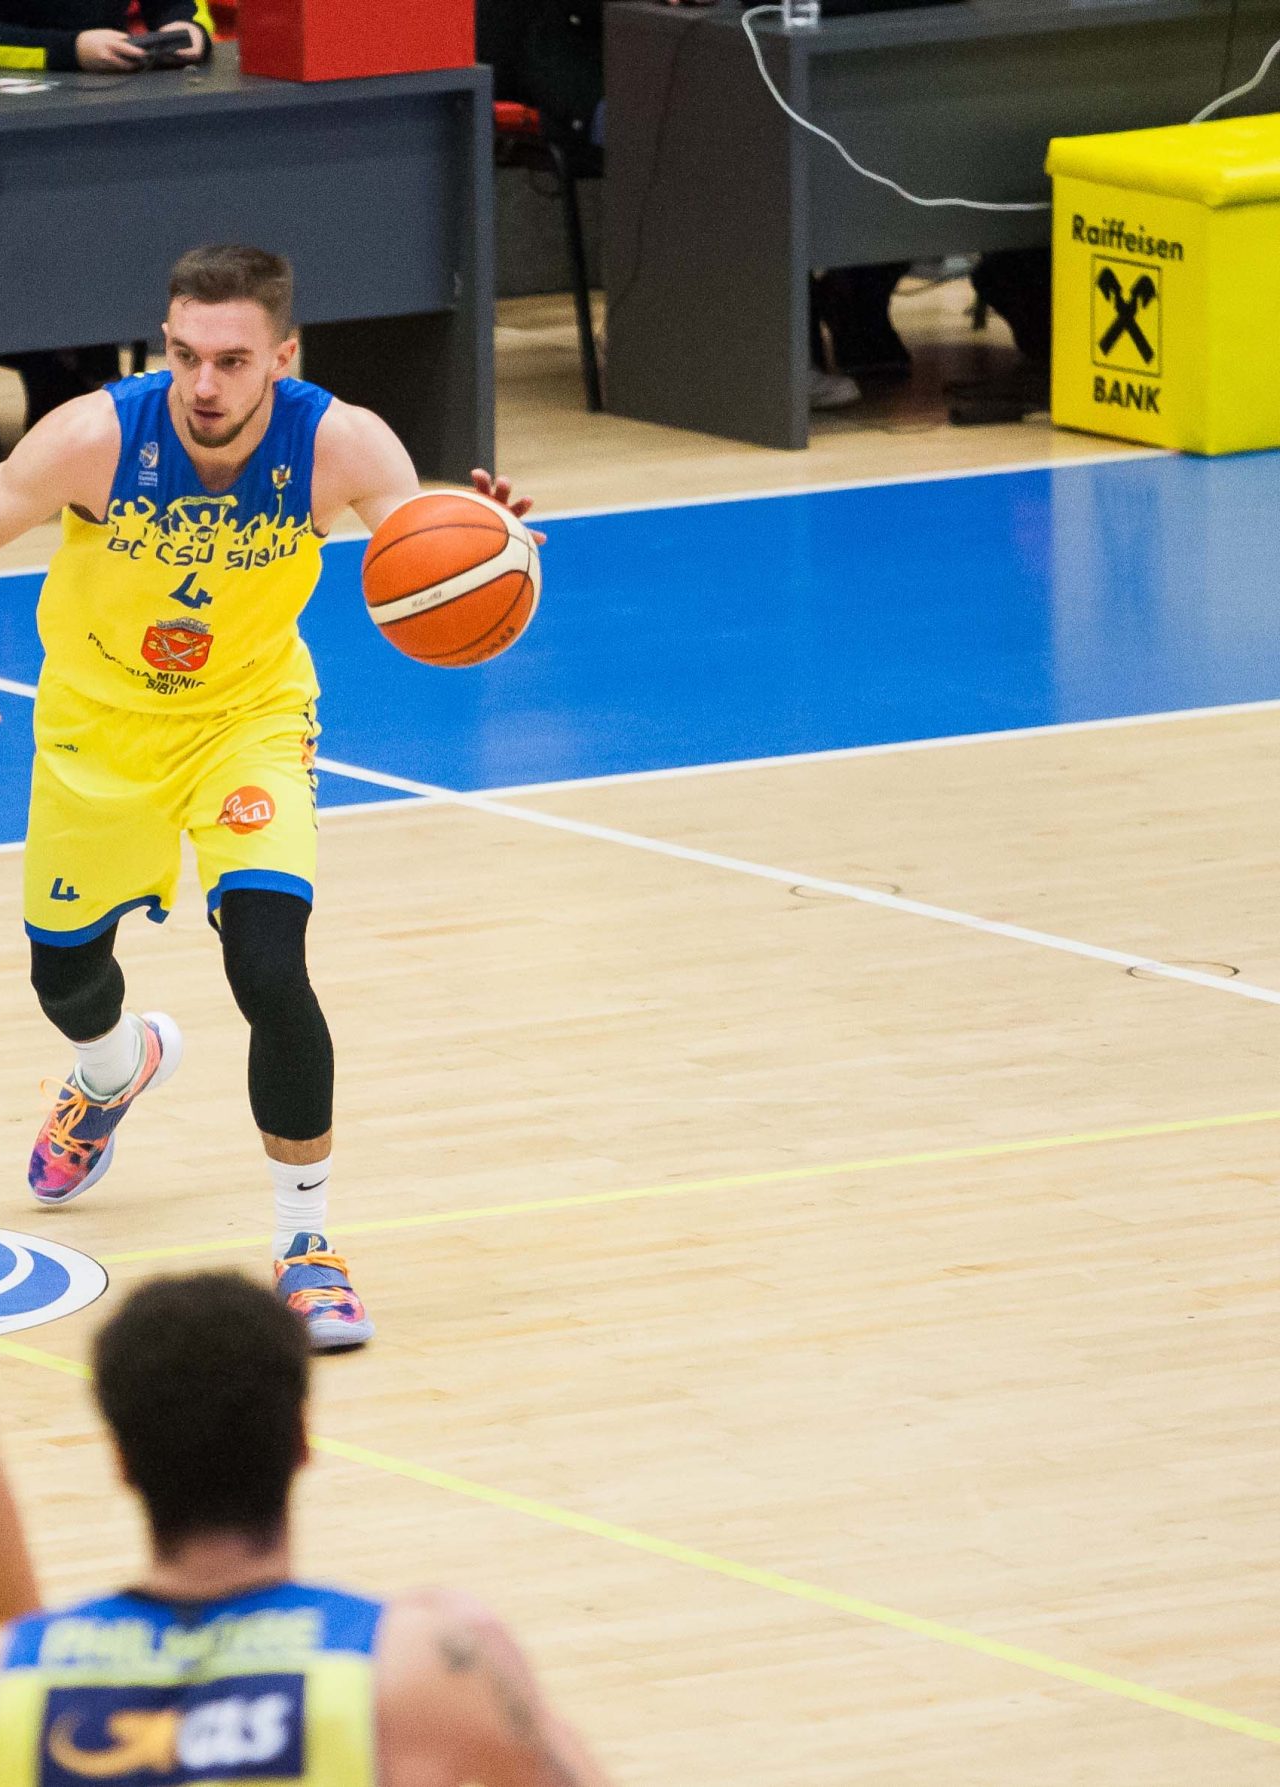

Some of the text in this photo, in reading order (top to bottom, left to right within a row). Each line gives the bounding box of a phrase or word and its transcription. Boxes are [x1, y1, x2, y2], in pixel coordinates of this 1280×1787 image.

[1072, 213, 1184, 262] Raiffeisen
[1092, 375, 1161, 414] BANK
[155, 541, 214, 566] CSU
[225, 540, 298, 570] SIBIU
[168, 571, 213, 609] 4
[87, 632, 152, 680] PRIMRIA
[50, 878, 80, 902] 4
